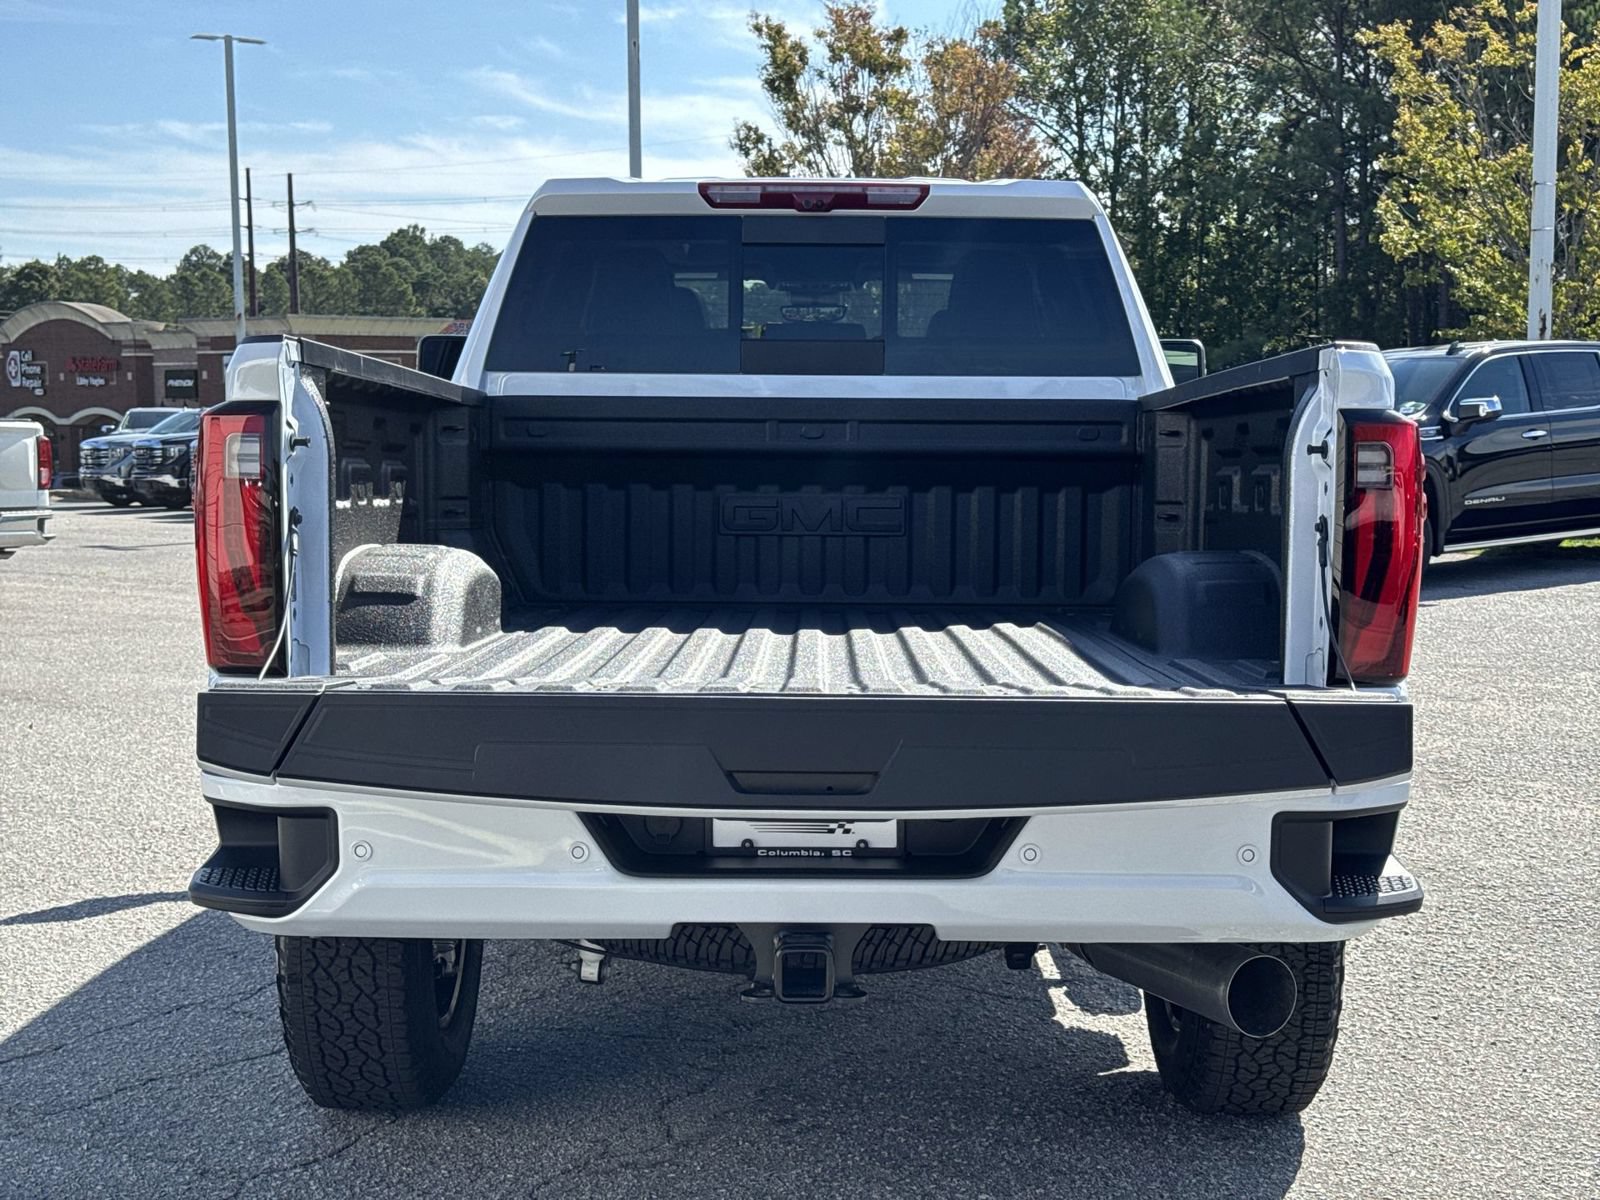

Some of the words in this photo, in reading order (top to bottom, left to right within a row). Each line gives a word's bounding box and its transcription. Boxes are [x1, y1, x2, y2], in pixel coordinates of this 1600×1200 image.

[21, 363, 41, 374] Phone
[1464, 496, 1505, 505] DENALI
[721, 495, 904, 532] GMC
[757, 849, 825, 857] Columbia,
[831, 849, 853, 857] SC
